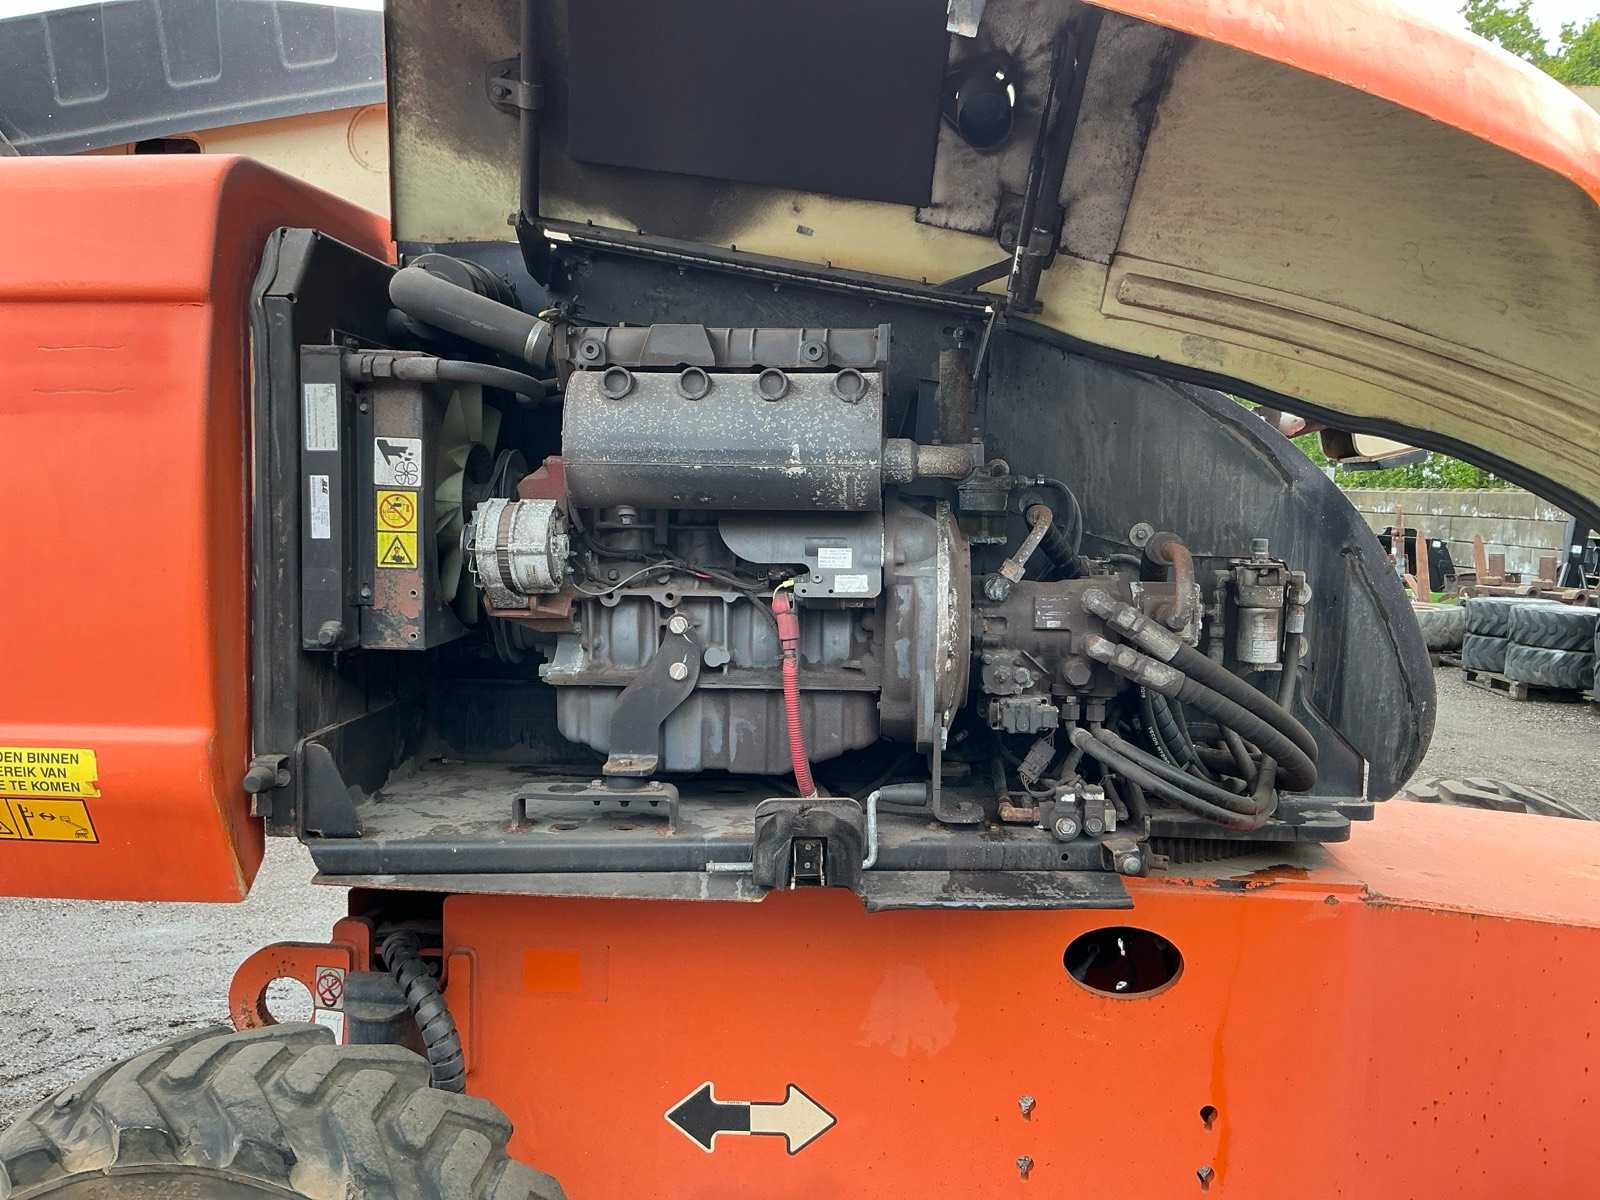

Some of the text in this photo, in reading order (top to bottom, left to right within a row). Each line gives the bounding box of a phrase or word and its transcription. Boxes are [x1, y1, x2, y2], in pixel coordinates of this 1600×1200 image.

[27, 752, 79, 765] BINNEN
[40, 767, 67, 779] VAN
[9, 780, 27, 791] TE
[31, 781, 81, 793] KOMEN
